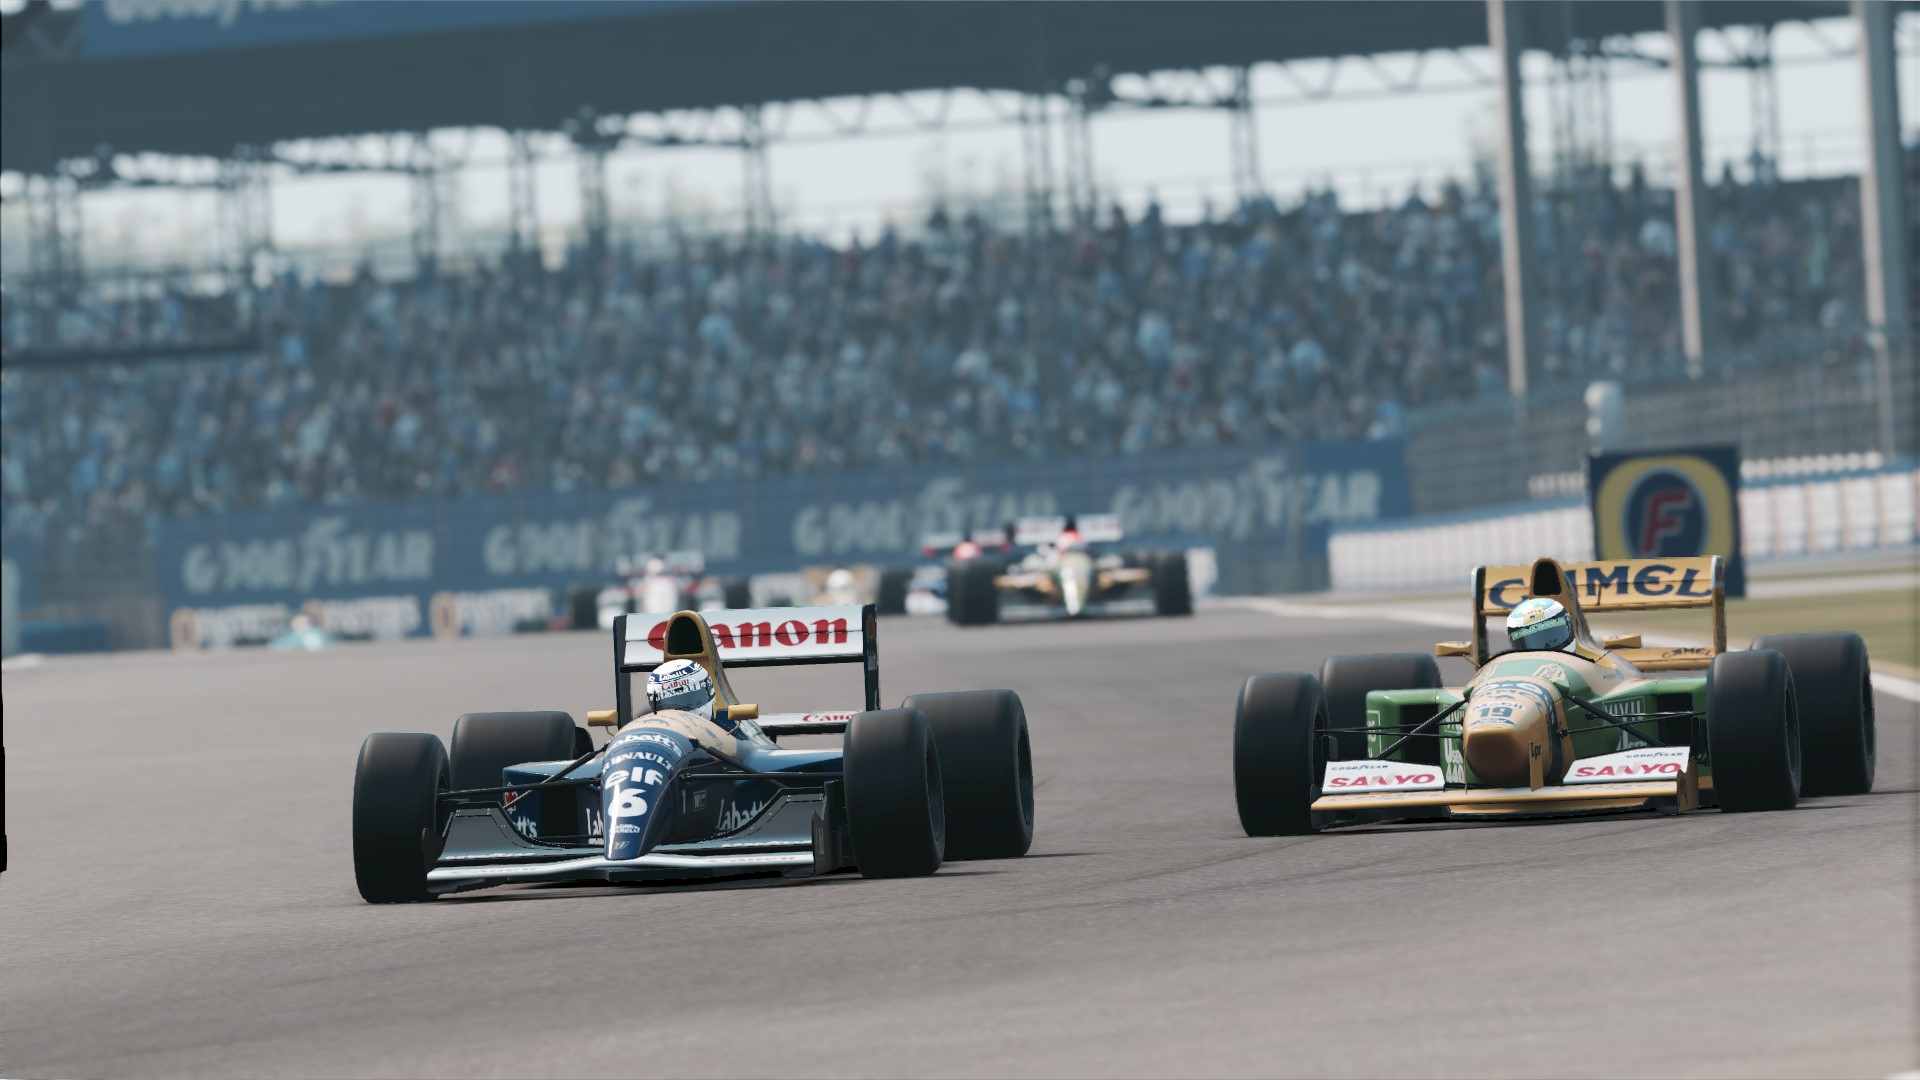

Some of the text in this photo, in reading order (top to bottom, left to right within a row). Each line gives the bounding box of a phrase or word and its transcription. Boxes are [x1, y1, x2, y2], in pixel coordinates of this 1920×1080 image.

[1479, 706, 1513, 719] 19
[1575, 762, 1681, 777] SANYO
[605, 766, 664, 790] elf
[1328, 773, 1436, 788] SANYO
[607, 787, 649, 818] 6
